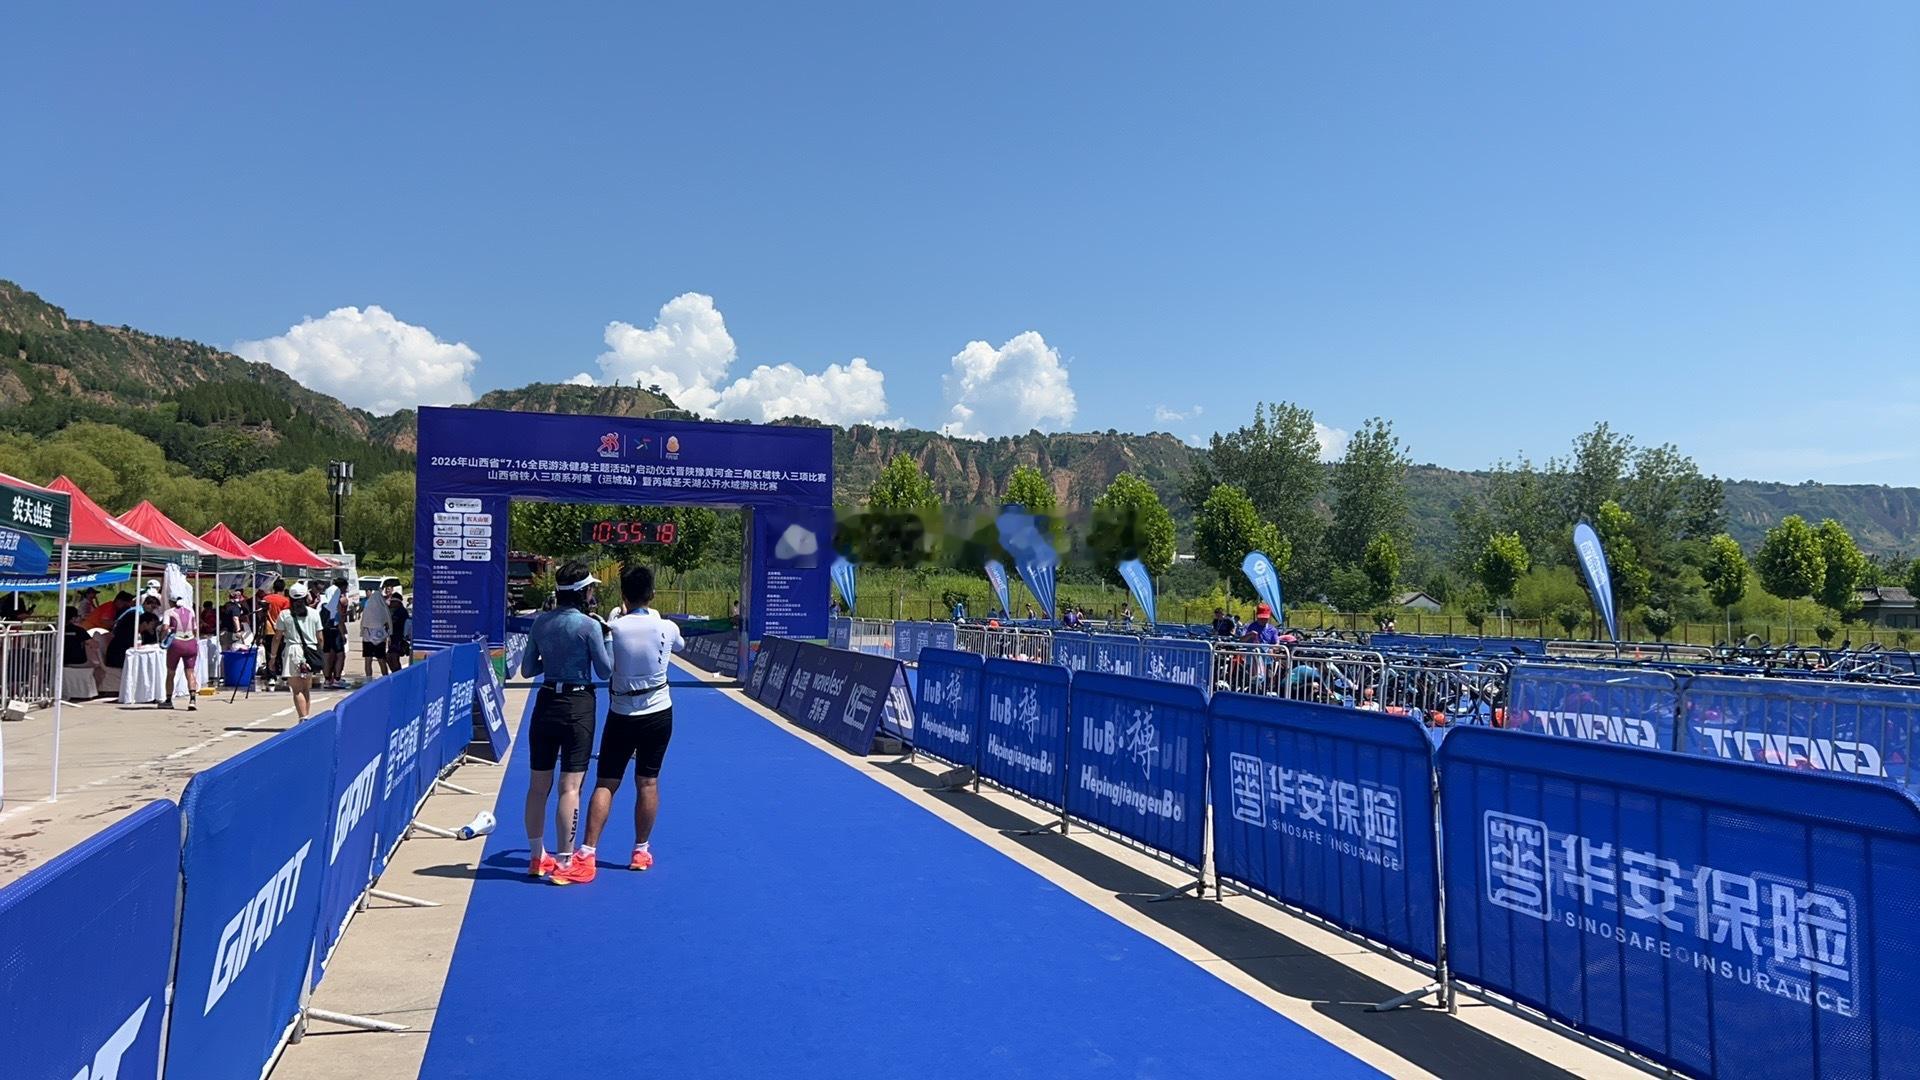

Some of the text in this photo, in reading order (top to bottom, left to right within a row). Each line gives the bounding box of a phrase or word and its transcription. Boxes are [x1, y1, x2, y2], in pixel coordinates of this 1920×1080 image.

[12, 495, 53, 528] 农夫山泉
[329, 752, 382, 866] GIANT
[1268, 764, 1398, 849] 华安保险
[1272, 818, 1399, 872] SINOSAFE INSURANCE
[203, 838, 313, 1018] GIANT
[1562, 834, 1851, 982] 华安保险
[1565, 910, 1852, 1017] SINOSAFE INSURANCE
